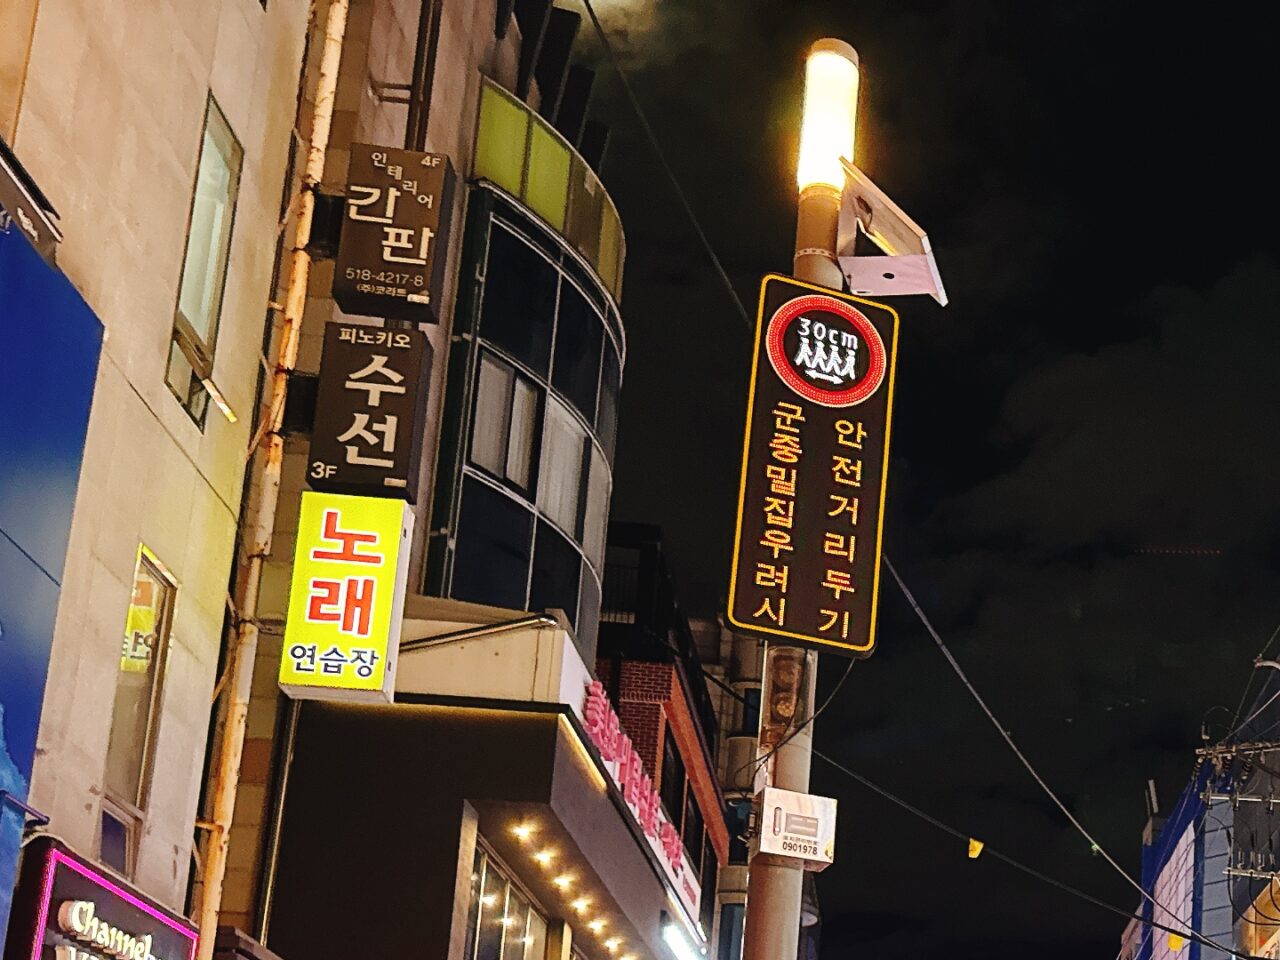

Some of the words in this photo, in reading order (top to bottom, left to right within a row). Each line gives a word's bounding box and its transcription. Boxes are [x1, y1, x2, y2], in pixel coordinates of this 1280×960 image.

[421, 155, 441, 168] 4F
[371, 152, 434, 209] 인테리어
[348, 185, 434, 266] 간판
[345, 267, 424, 287] 518-4217-8
[339, 328, 411, 349] 피노키오
[797, 317, 858, 350] 30cm
[336, 354, 406, 468] 수선
[311, 460, 337, 479] 3F
[307, 510, 384, 637] 노래
[290, 644, 379, 679] 연습장
[782, 841, 818, 856] 0901978
